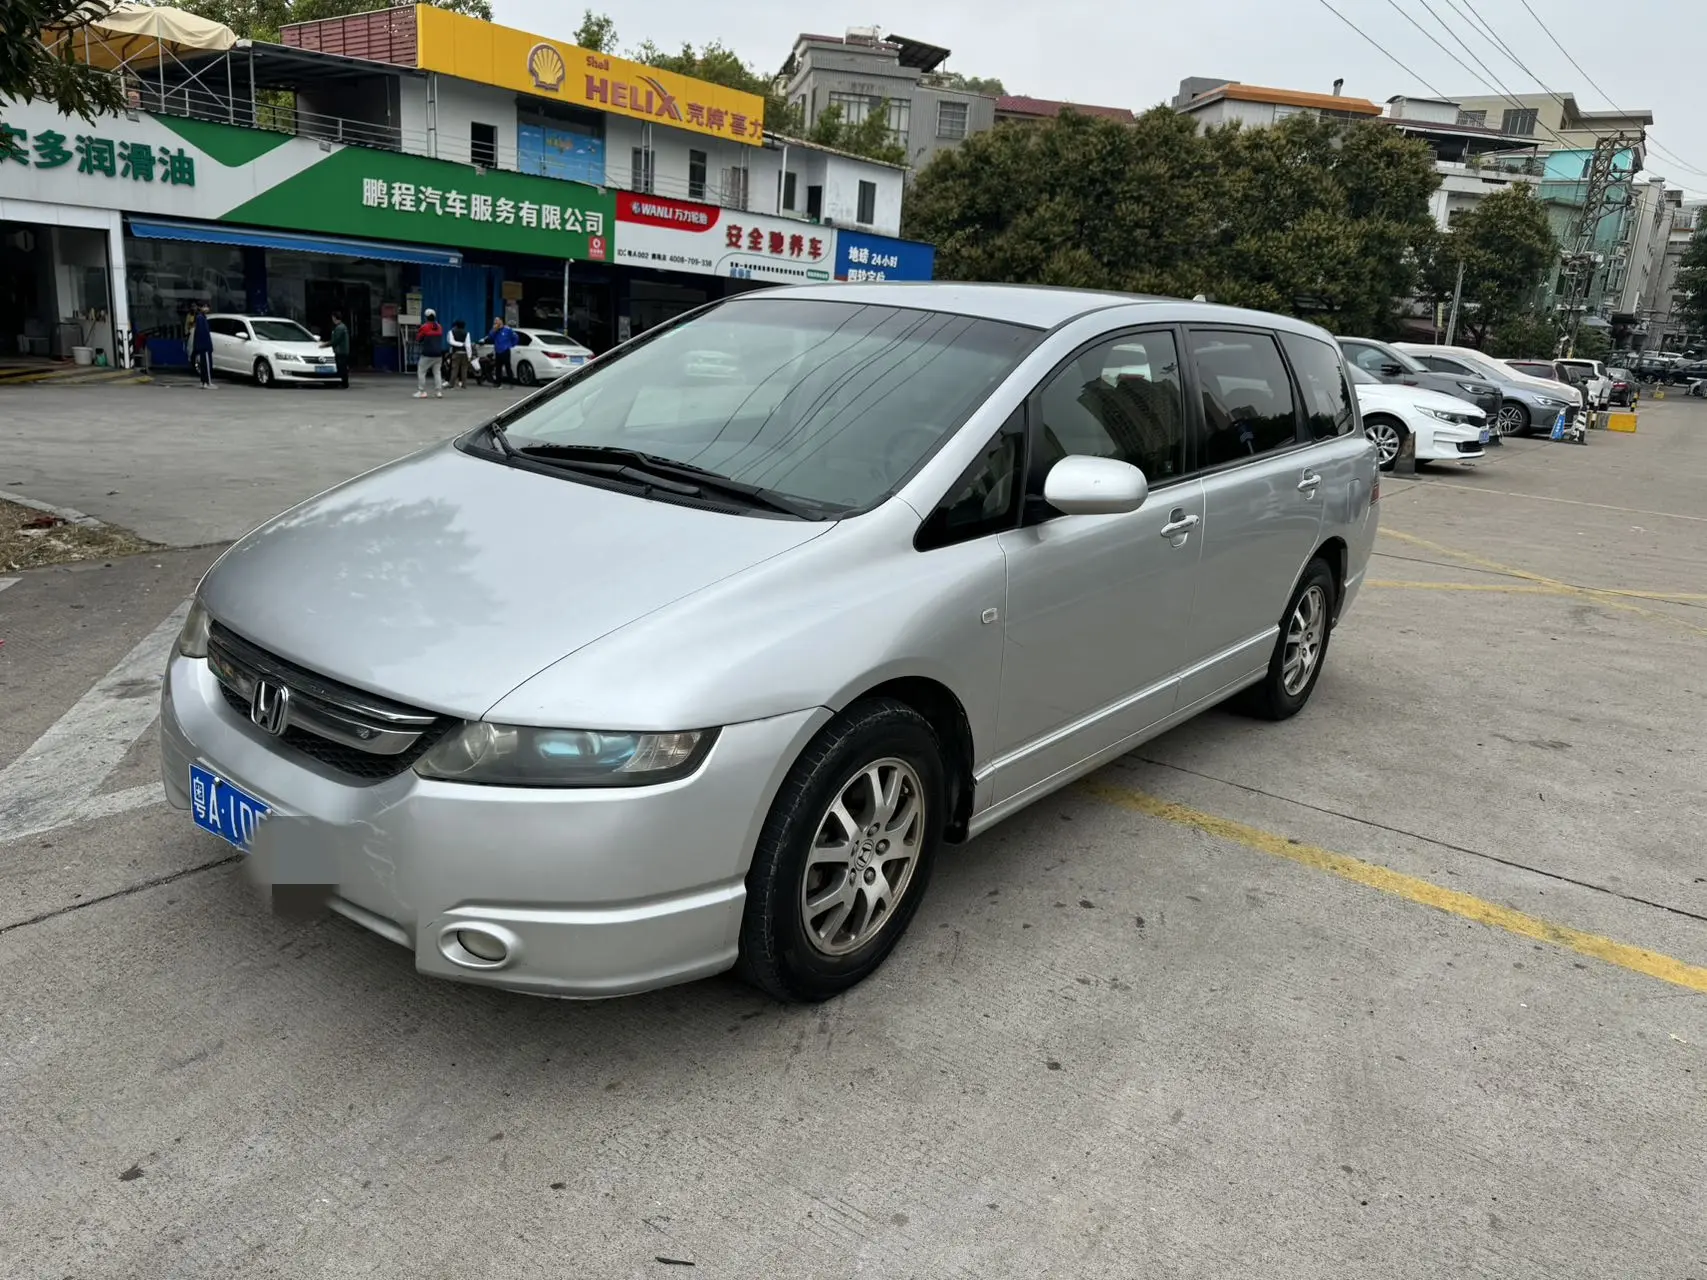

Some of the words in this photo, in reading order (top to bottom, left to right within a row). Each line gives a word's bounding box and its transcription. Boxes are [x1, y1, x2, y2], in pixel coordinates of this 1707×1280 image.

[586, 55, 609, 71] Shell
[585, 74, 683, 122] HELIX
[362, 177, 603, 236] 鹏程汽车服务有限公司
[641, 203, 673, 219] WANLI
[871, 253, 898, 268] 24小时
